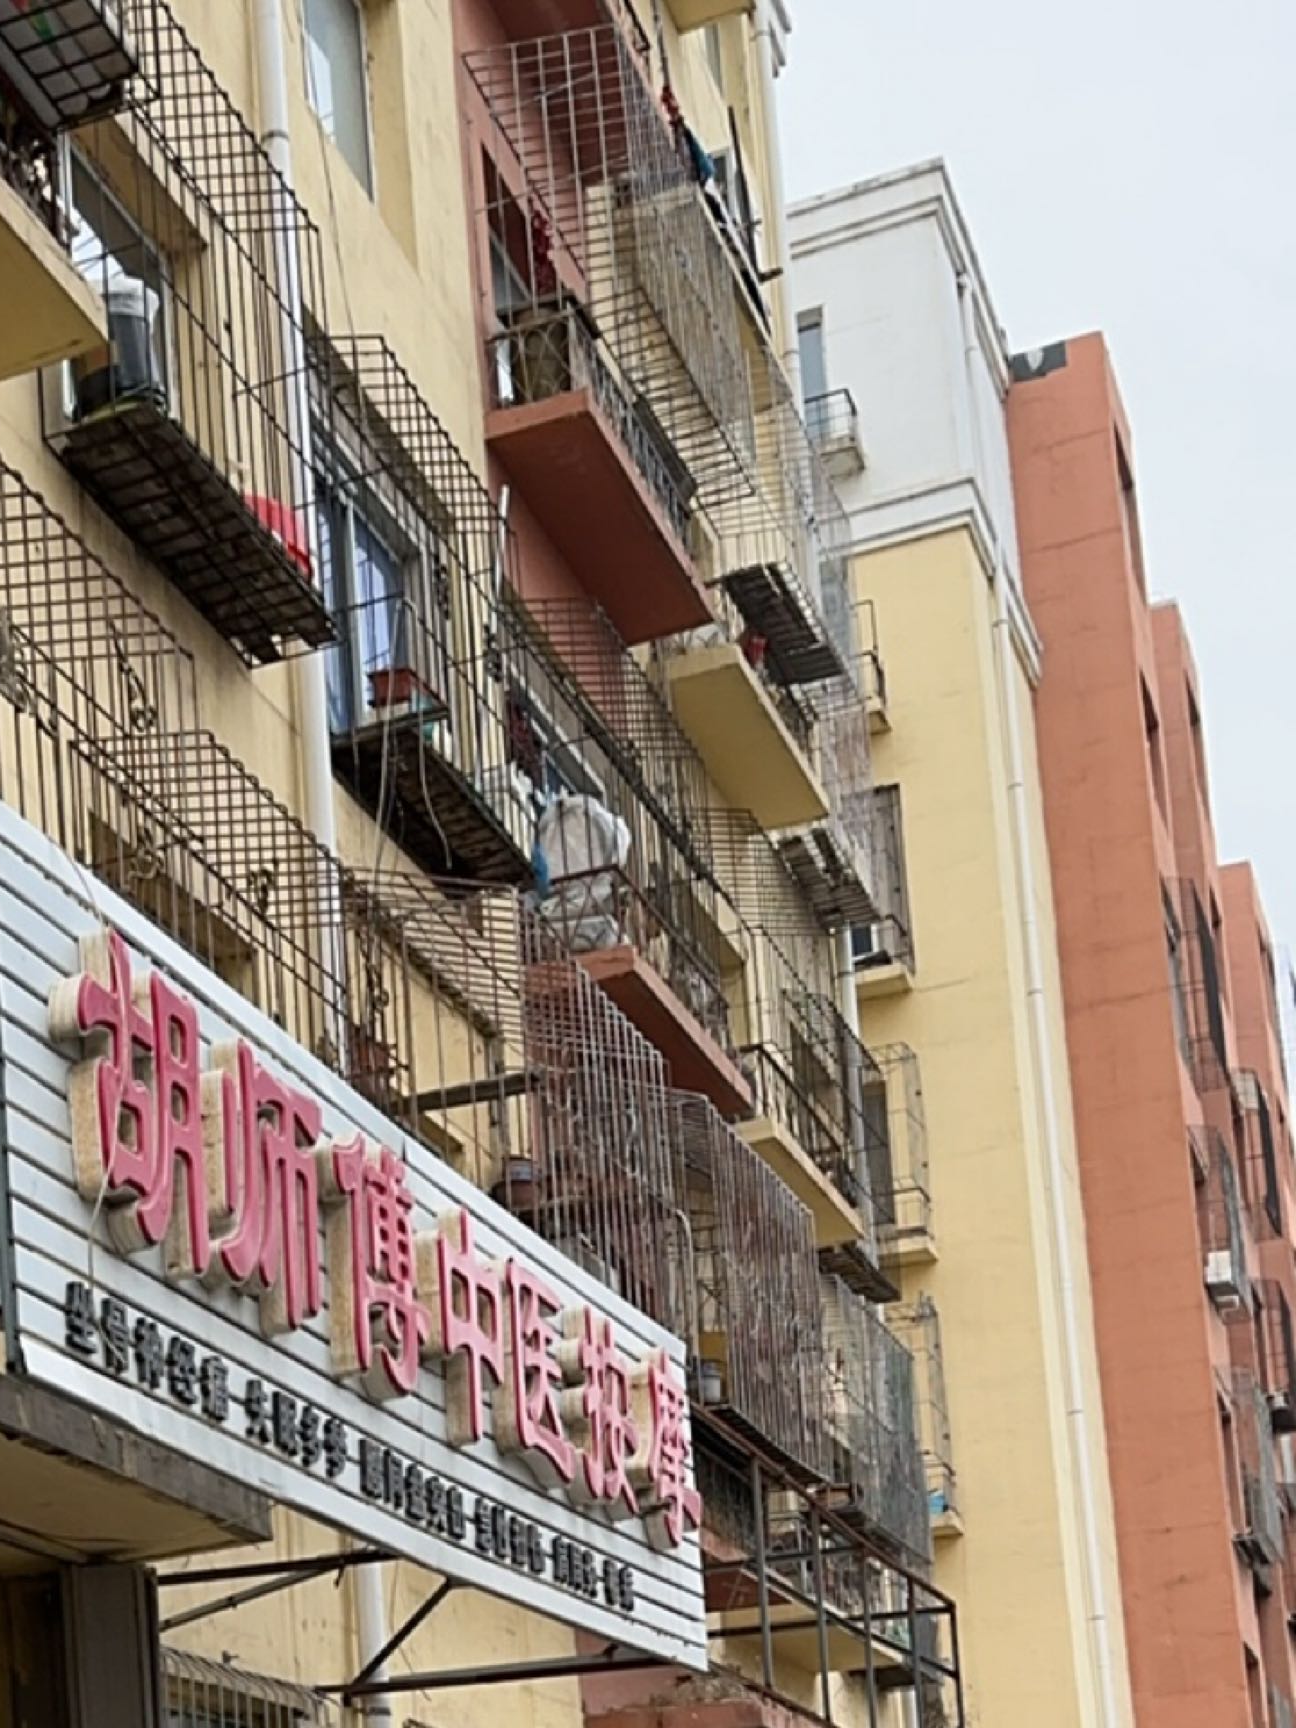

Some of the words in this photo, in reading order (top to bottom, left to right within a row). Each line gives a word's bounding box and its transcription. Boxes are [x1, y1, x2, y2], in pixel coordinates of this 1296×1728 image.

[56, 926, 702, 1548] 胡师傅中医按摩
